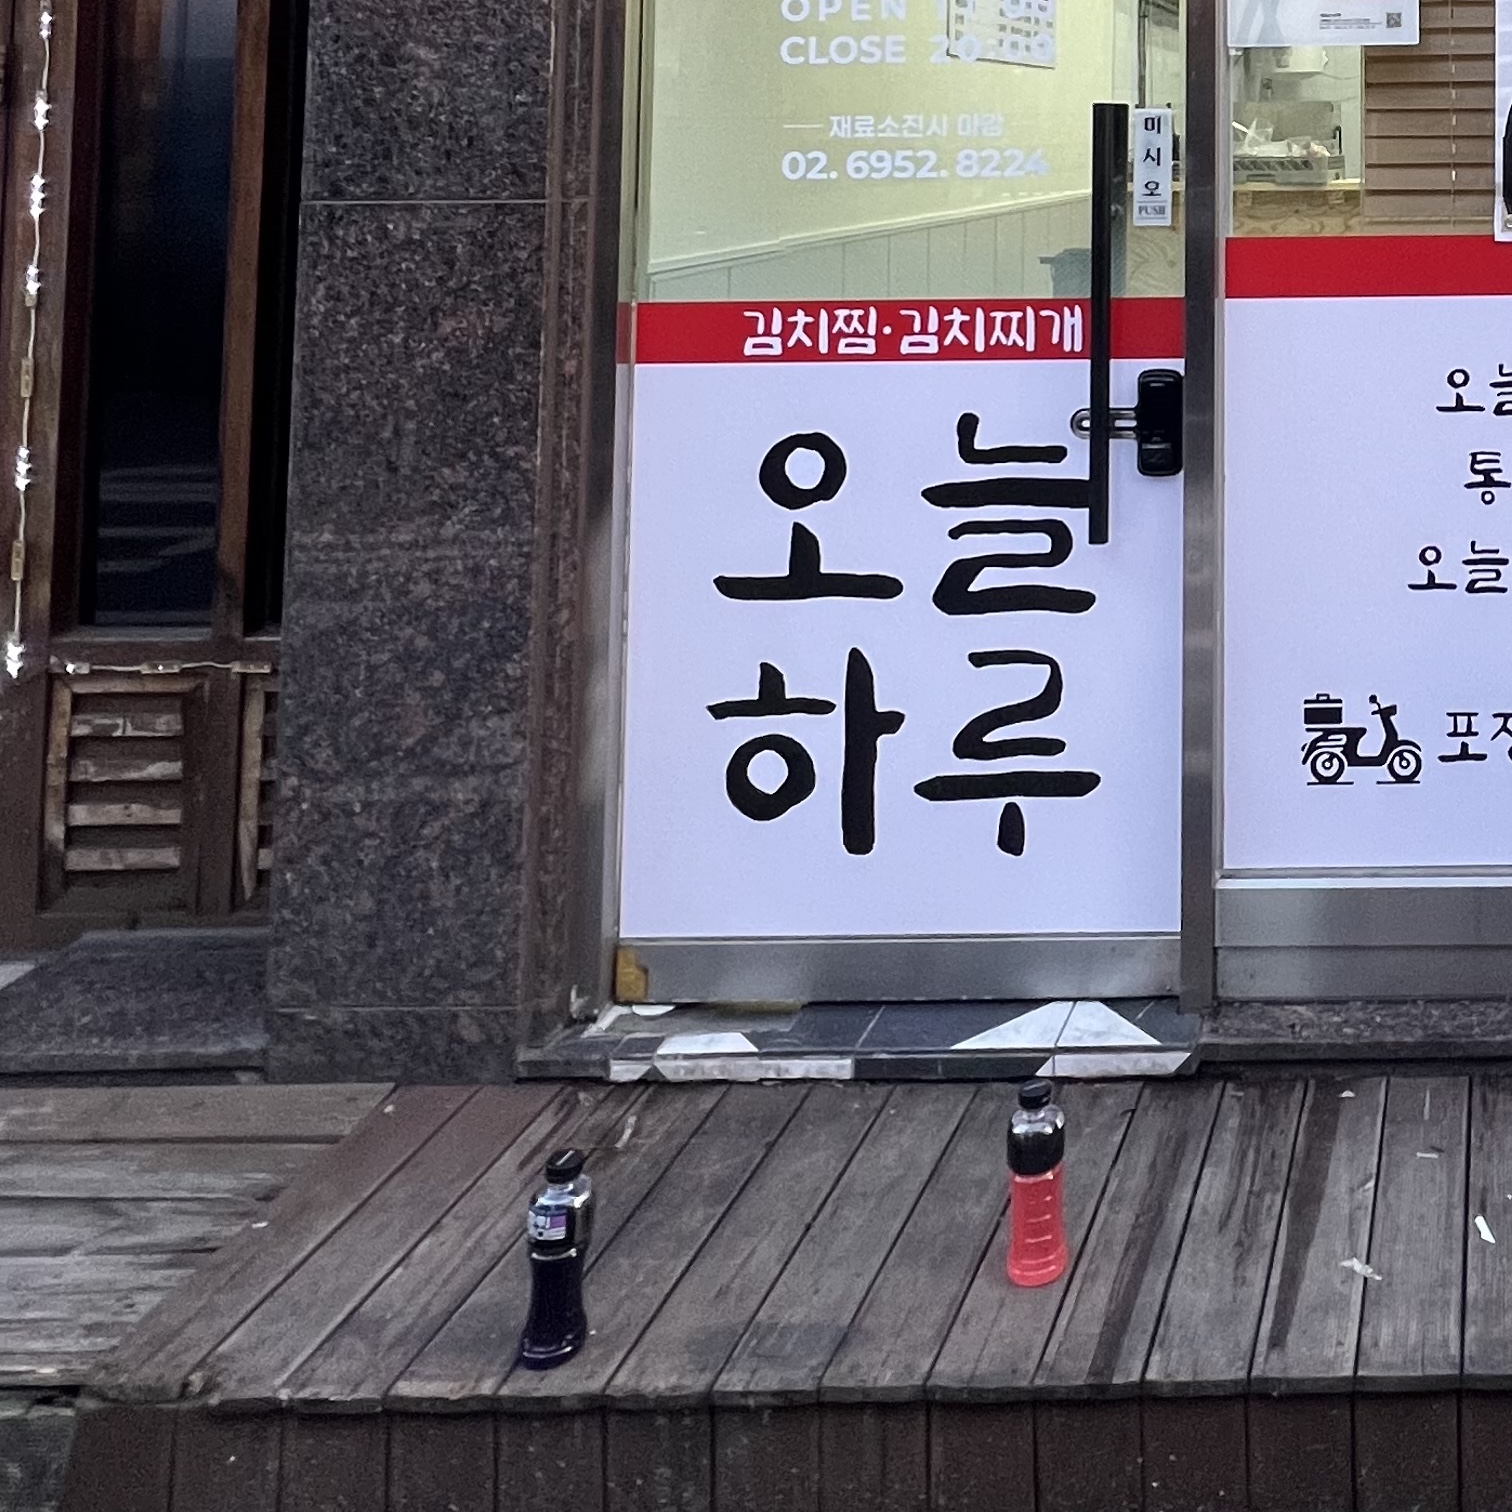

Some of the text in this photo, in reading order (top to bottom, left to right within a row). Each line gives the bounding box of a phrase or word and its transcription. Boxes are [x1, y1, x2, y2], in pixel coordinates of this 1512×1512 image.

[780, 35, 907, 65] CLOSE
[829, 113, 1006, 138] 재료소진시 마감
[1143, 116, 1163, 196] 미시오
[1138, 205, 1166, 215] PUSH
[743, 306, 1083, 356] 김치찜·김치찌개
[713, 412, 1097, 615] 오늘
[706, 647, 1102, 856] 하루
